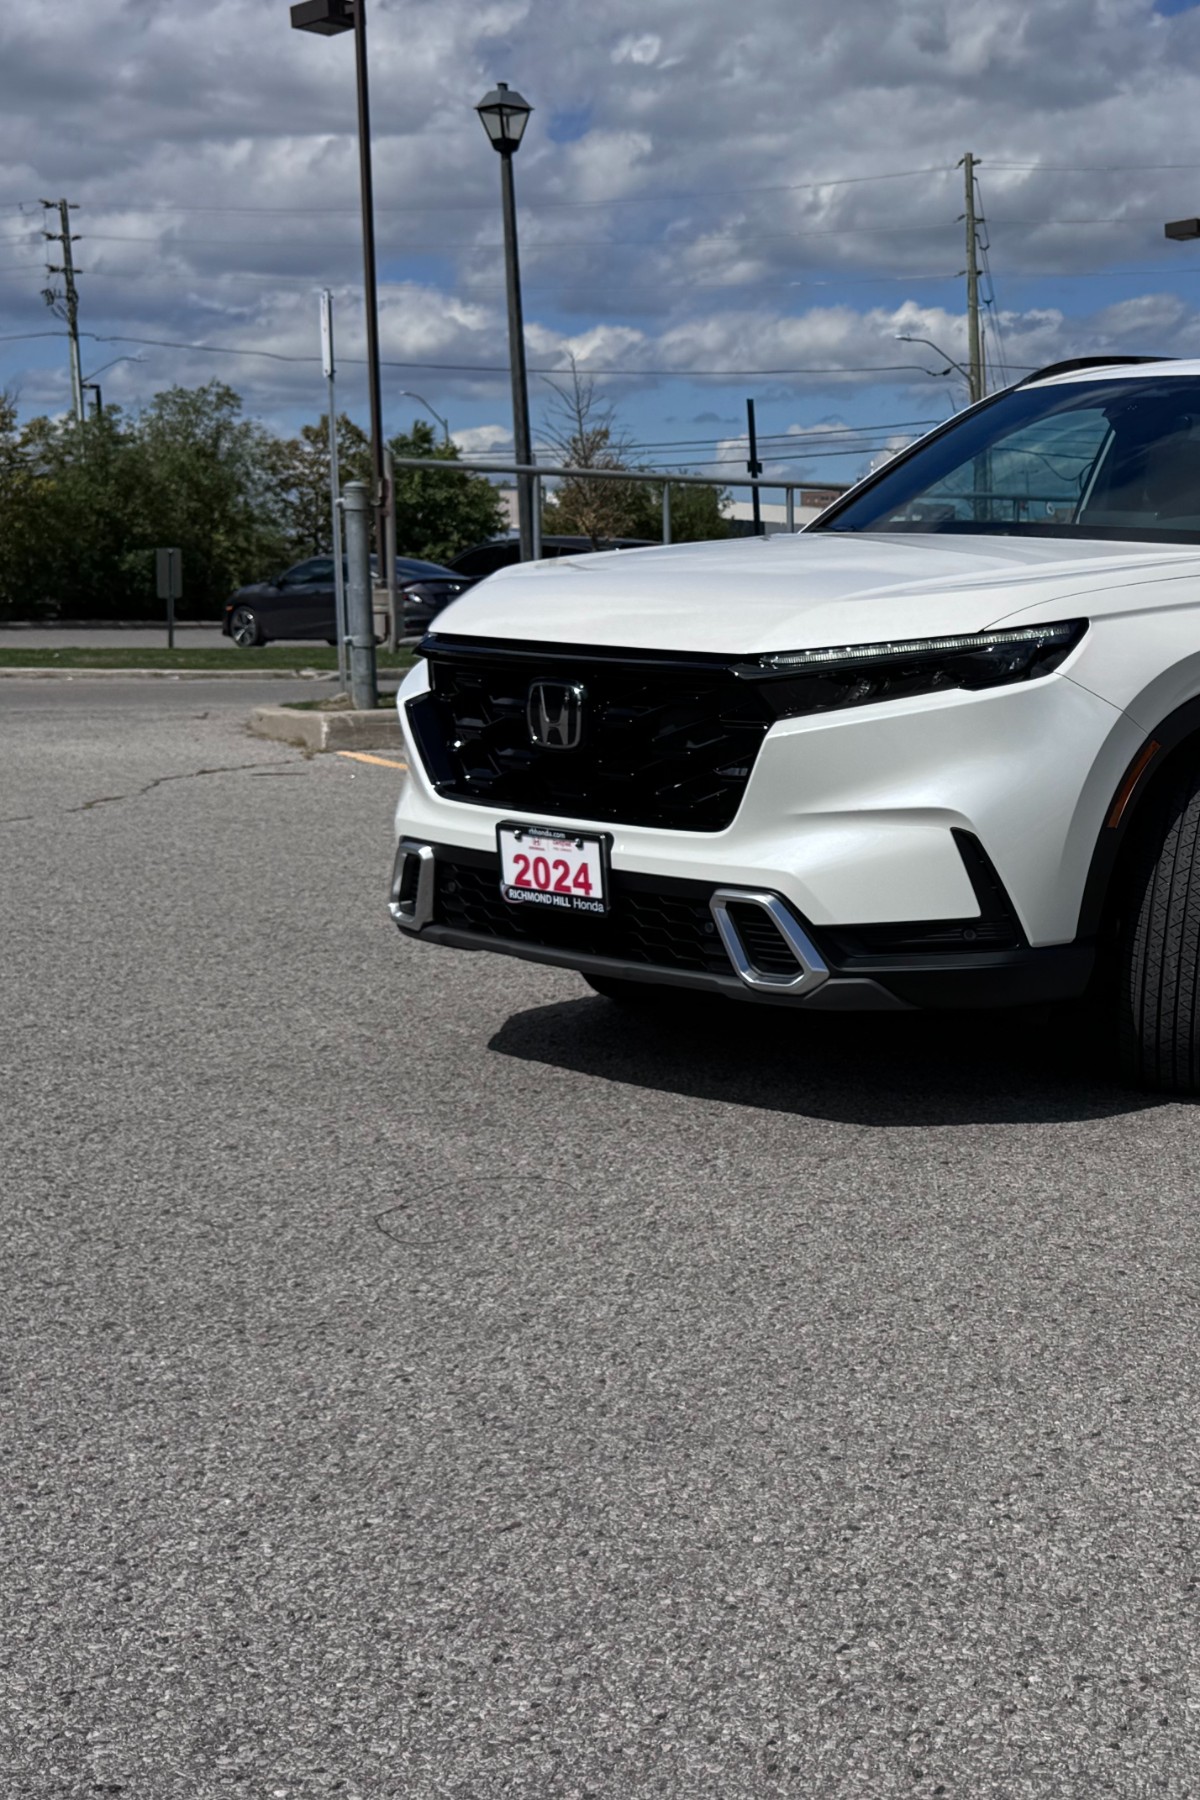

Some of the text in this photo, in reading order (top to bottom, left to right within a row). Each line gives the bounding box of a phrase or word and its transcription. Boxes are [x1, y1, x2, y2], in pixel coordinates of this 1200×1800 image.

[512, 853, 593, 897] 2024
[508, 887, 605, 913] RICHMOND HILL Honda
